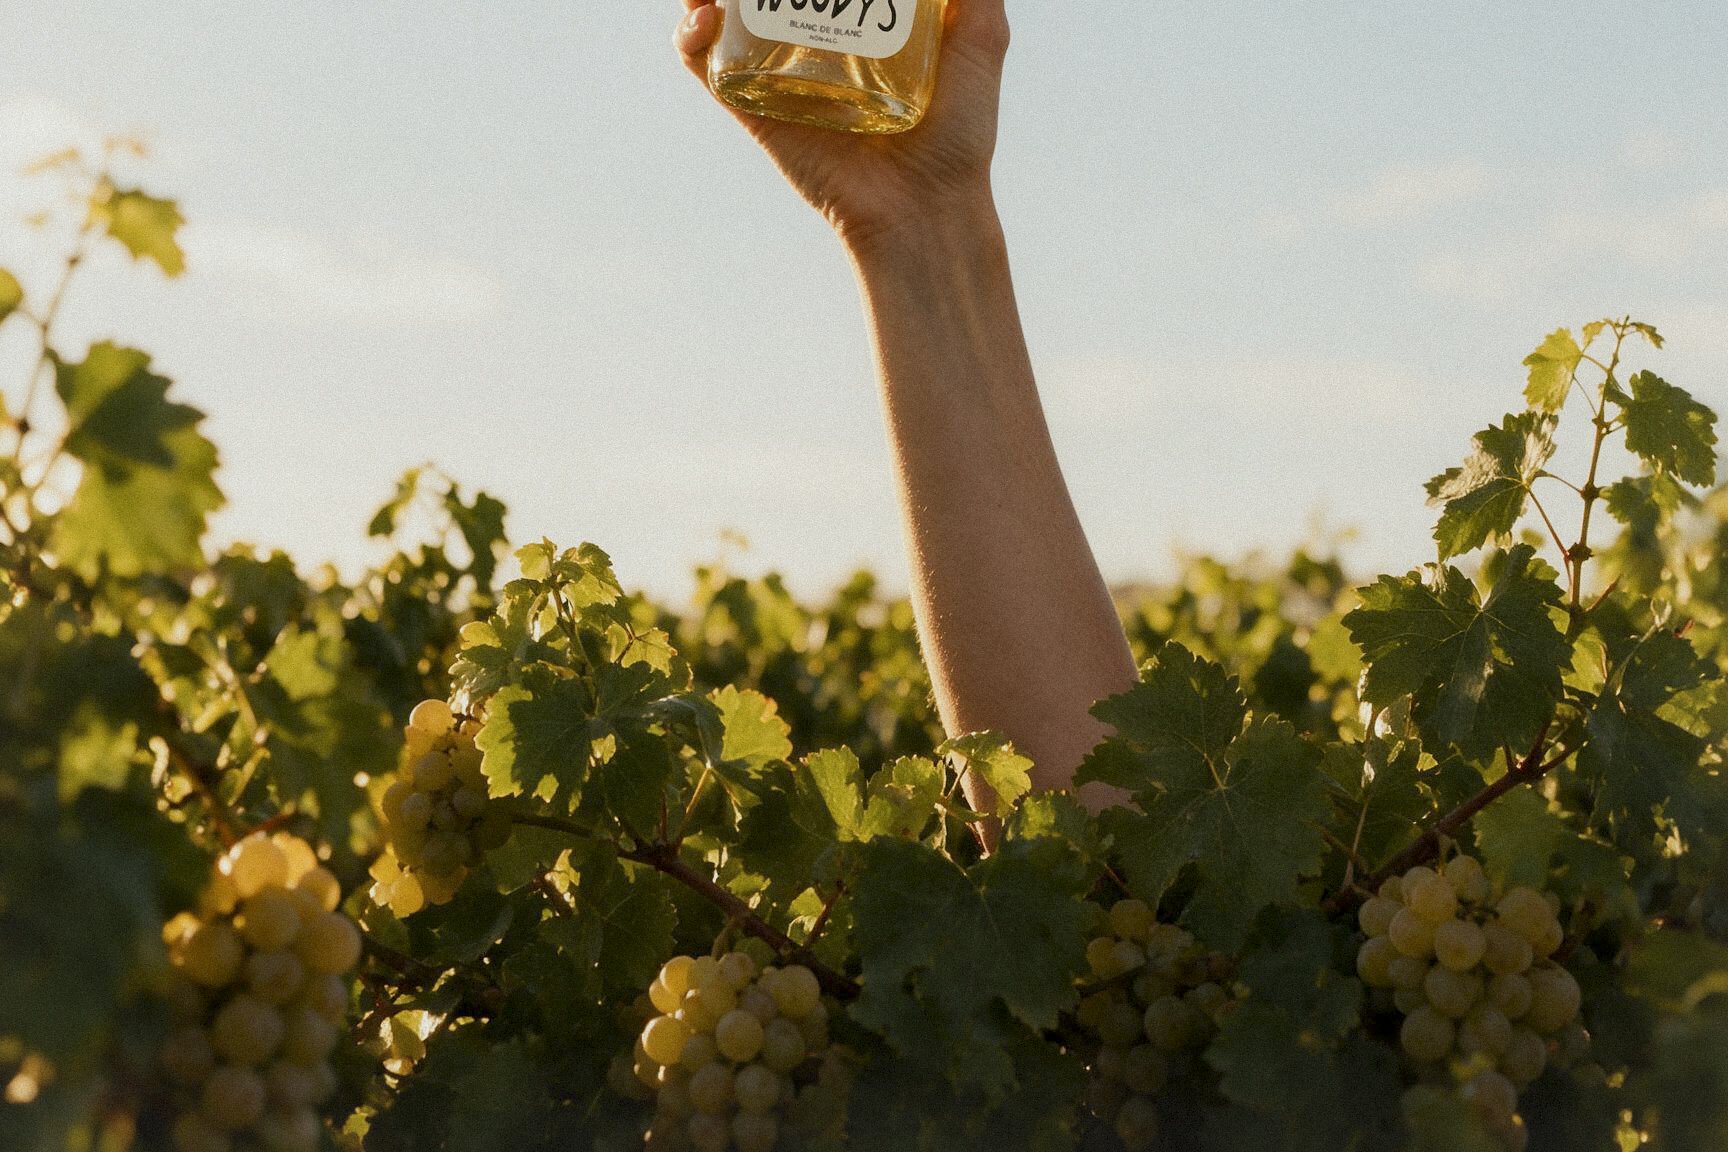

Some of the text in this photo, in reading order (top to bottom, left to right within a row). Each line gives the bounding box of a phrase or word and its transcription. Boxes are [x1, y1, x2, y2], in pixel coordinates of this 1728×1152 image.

[789, 19, 862, 38] BLANC DE BLANC
